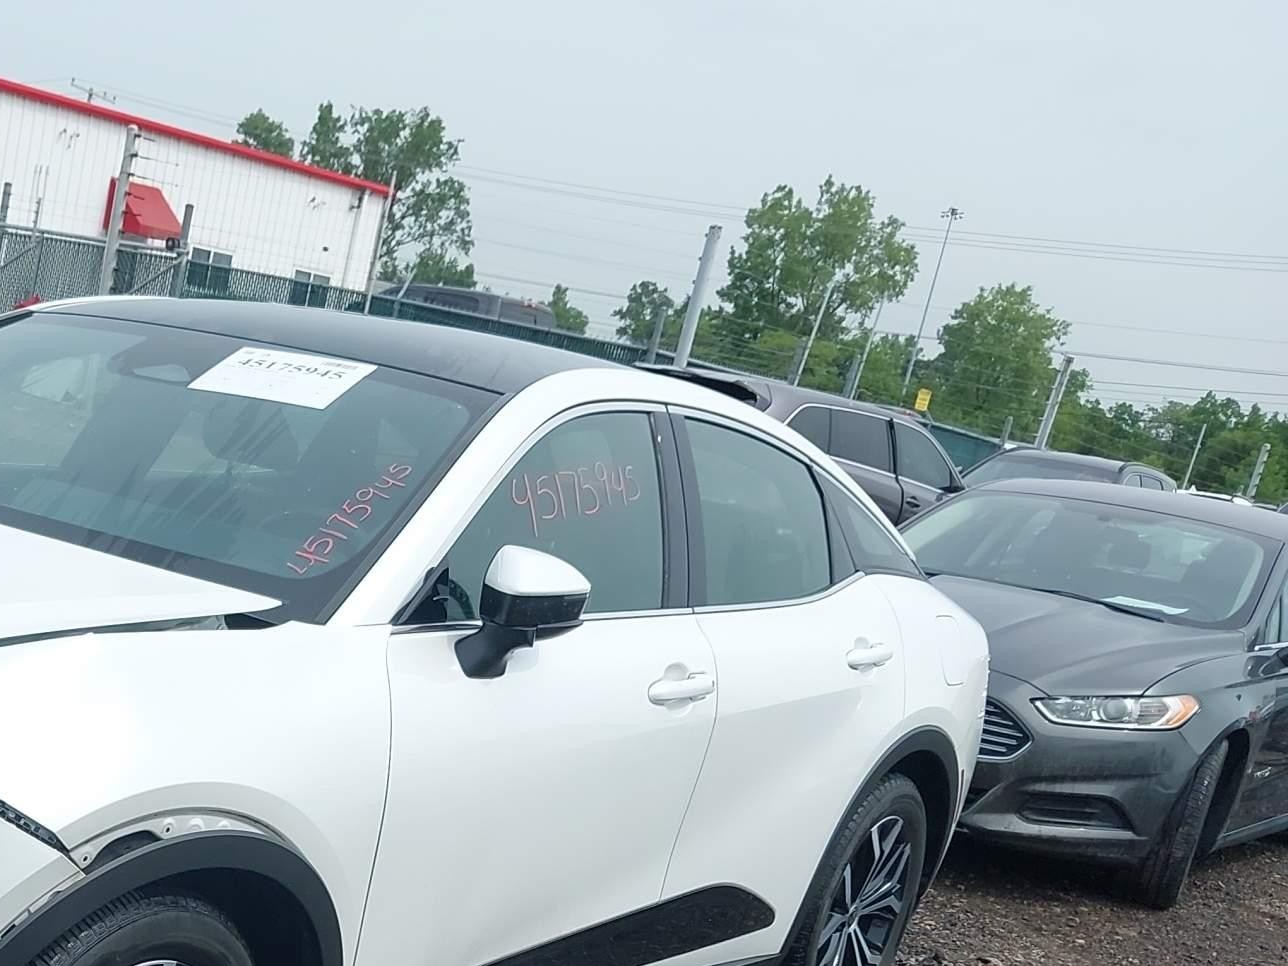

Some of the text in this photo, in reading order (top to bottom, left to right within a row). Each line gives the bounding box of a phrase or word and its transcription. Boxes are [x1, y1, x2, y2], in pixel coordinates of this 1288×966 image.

[238, 358, 348, 380] 45175945
[286, 463, 413, 575] 45175945
[511, 461, 641, 537] 45175945
